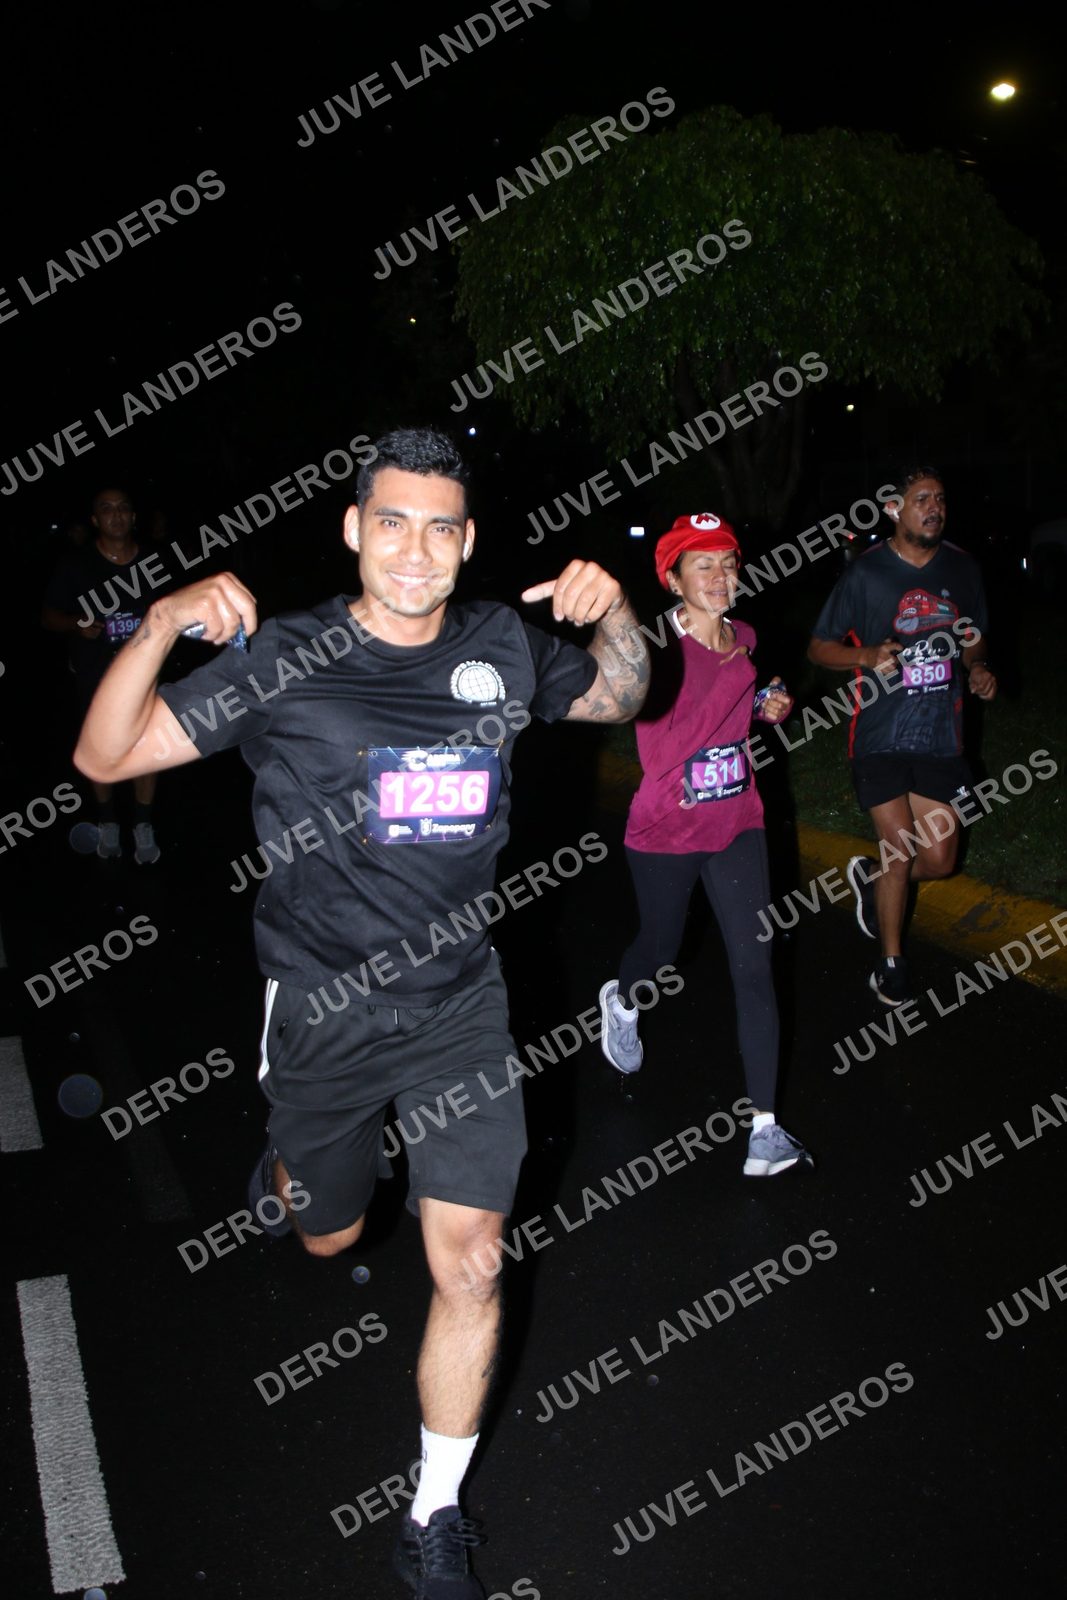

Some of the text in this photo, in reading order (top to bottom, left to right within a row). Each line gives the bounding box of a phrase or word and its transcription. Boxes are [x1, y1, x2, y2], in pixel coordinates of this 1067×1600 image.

[911, 664, 946, 685] 850
[703, 758, 738, 787] 511
[386, 774, 486, 814] 1256
